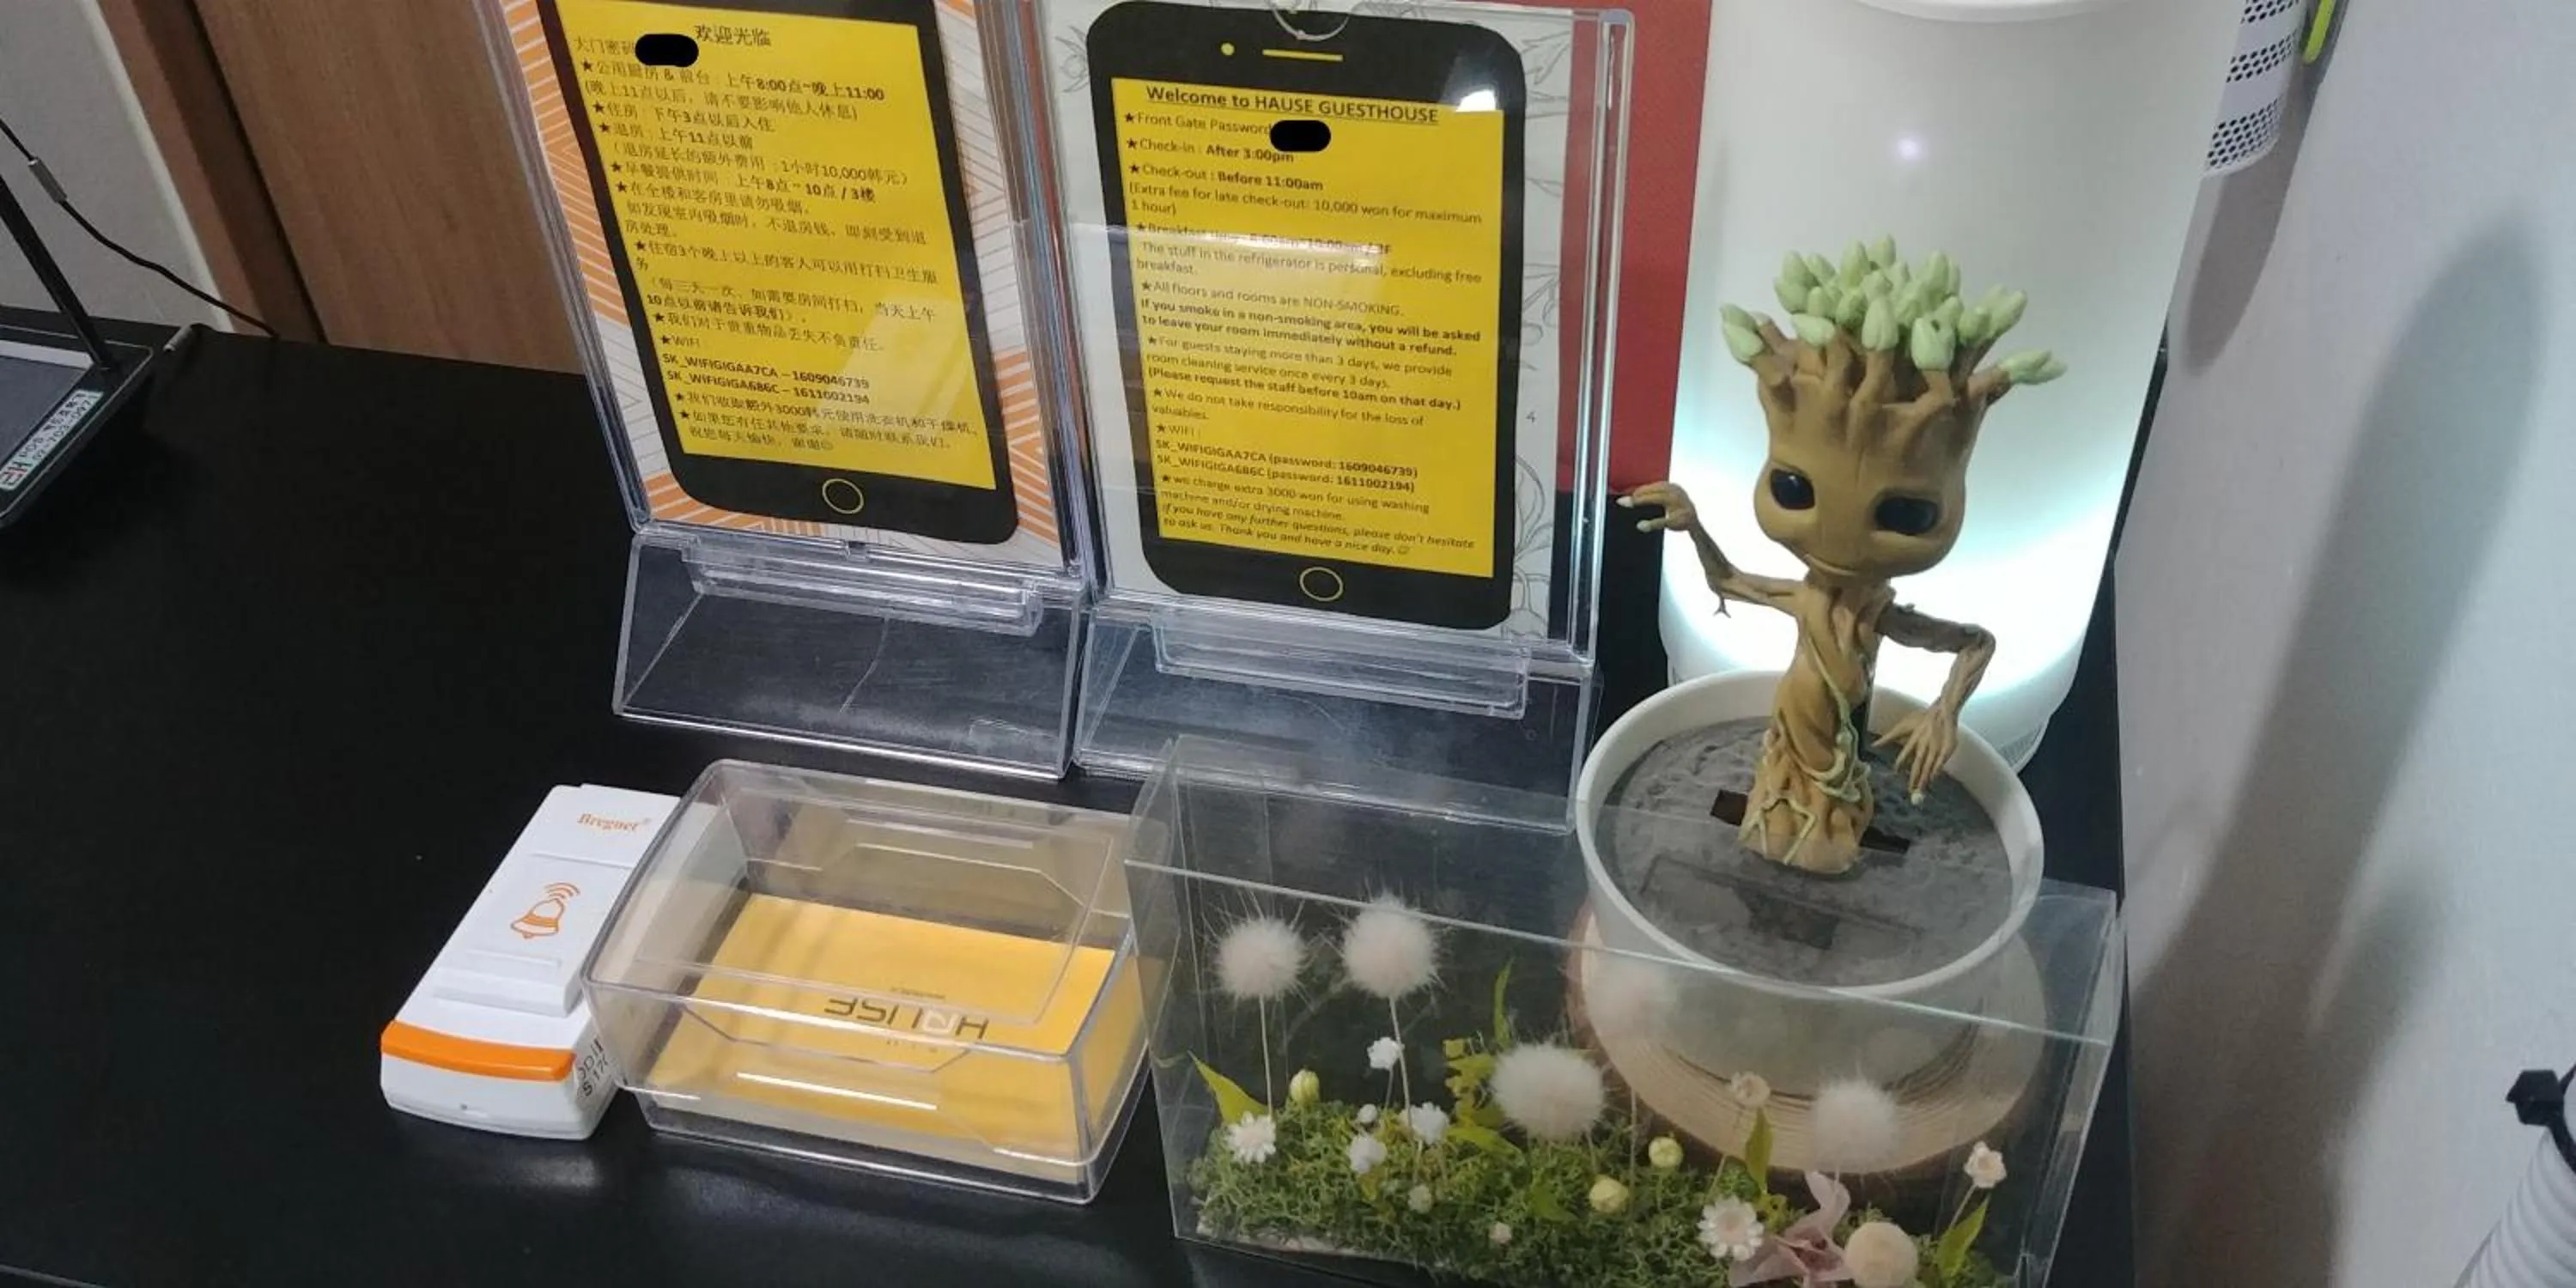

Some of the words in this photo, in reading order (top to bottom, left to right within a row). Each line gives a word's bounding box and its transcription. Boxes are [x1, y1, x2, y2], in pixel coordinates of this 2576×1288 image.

[691, 22, 773, 48] 欢迎光临
[661, 67, 674, 81] &
[1145, 85, 1228, 106] Welcome
[1231, 94, 1249, 108] to
[1255, 94, 1313, 113] HAUSE
[1317, 100, 1439, 124] GUESTHOUSE
[1136, 111, 1173, 126] Front
[1175, 114, 1206, 130] Gate
[1208, 116, 1272, 135] Password
[1139, 137, 1195, 155] Check-in
[1205, 143, 1239, 158] After
[1243, 147, 1294, 165] 3:00pm
[1142, 163, 1206, 180] Check-out
[1217, 170, 1262, 185] Before
[1265, 174, 1323, 191] 11:00am
[1128, 180, 1164, 197] (Extra
[1168, 185, 1189, 198] fee
[1192, 186, 1211, 200] for
[1214, 189, 1238, 203] late
[1242, 191, 1309, 210] check-out:
[1315, 198, 1358, 216] 10,000
[1361, 205, 1388, 217] won
[1393, 204, 1413, 218] for
[1415, 207, 1482, 225] maximum
[1130, 198, 1140, 210] 1
[1140, 198, 1176, 216] hour)
[1135, 257, 1196, 275] breakfast.
[1142, 240, 1164, 254] The
[1168, 244, 1197, 258] stuff
[1199, 247, 1211, 259] in
[1212, 248, 1236, 262] the
[1237, 251, 1309, 272] refrigerator
[1314, 258, 1325, 270] is
[1327, 259, 1386, 278] personal,
[1389, 264, 1452, 283] excluding
[1455, 269, 1481, 283] free
[1152, 280, 1170, 293] All
[1172, 282, 1207, 297] floors
[1211, 286, 1233, 300] and
[1236, 291, 1277, 304] rooms
[1279, 296, 1300, 307] are
[1302, 295, 1404, 317] NON-SMOKING.
[1140, 298, 1150, 310] If
[1151, 301, 1175, 313] you
[1178, 302, 1220, 317] smoke
[1222, 307, 1233, 319] in
[1236, 310, 1245, 319] a
[1248, 309, 1332, 330] non-smoking
[1334, 319, 1365, 332] area,
[1370, 322, 1393, 336] you
[1396, 323, 1419, 337] will
[1423, 325, 1438, 338] be
[1442, 327, 1480, 342] asked
[1142, 315, 1156, 325] to
[1158, 315, 1192, 329] leave
[1194, 321, 1223, 334] your
[1225, 324, 1259, 337] room
[1262, 326, 1341, 348] immediately
[1345, 334, 1395, 350] without
[1399, 343, 1406, 351] a
[1409, 340, 1456, 356] refund.
[1158, 336, 1178, 348] For
[1181, 339, 1221, 354] guests
[1223, 343, 1267, 359] staying
[1269, 349, 1303, 361] more
[1304, 351, 1333, 364] than
[1337, 355, 1343, 365] 3
[1346, 355, 1378, 371] days,
[1382, 361, 1400, 372] we
[1404, 361, 1452, 379] provide
[791, 369, 870, 390] 1609046739
[1145, 354, 1179, 365] room
[1180, 355, 1232, 373] cleaning
[1234, 361, 1276, 376] service
[1278, 368, 1309, 380] once
[1311, 371, 1346, 385] every
[1349, 374, 1356, 385] 3
[1359, 374, 1390, 390] days.
[792, 386, 871, 405] 1611002194
[1147, 366, 1191, 382] (Please
[1194, 372, 1241, 388] request
[1243, 377, 1265, 390] the
[1267, 379, 1296, 393] staff
[1297, 382, 1340, 398] before
[1342, 389, 1377, 402] 10am
[1379, 393, 1396, 404] on
[1400, 394, 1425, 407] that
[1428, 395, 1461, 411] day.)
[1151, 403, 1209, 420] valuables.
[1163, 388, 1183, 400] We
[1187, 391, 1203, 402] do
[1204, 393, 1225, 404] not
[1228, 395, 1254, 408] take
[1257, 398, 1338, 419] responsibility
[1340, 407, 1358, 420] for
[1361, 410, 1381, 422] the
[1384, 411, 1408, 425] loss
[1411, 414, 1424, 426] of
[1526, 410, 1536, 422] 4
[1268, 451, 1336, 471] (password:
[1339, 458, 1418, 478] 1609046739)
[1266, 466, 1334, 486] (password:
[1336, 472, 1415, 494] 1611002194)
[1160, 488, 1210, 504] machine
[1211, 495, 1251, 510] and/or
[1252, 500, 1290, 516] drying
[1173, 476, 1189, 485] we
[1192, 476, 1230, 492] charge
[1233, 482, 1263, 494] extra
[1266, 485, 1296, 499] 3000
[1298, 490, 1323, 501] won
[1326, 492, 1344, 504] for
[1346, 495, 1378, 509] using
[1381, 498, 1430, 515] washing
[1163, 517, 1176, 526] to
[1177, 517, 1199, 529] ask
[1218, 523, 1253, 536] Thank
[1255, 529, 1277, 541] you
[1279, 531, 1302, 542] and
[1304, 533, 1332, 546] have
[1334, 538, 1341, 547] a
[1344, 538, 1369, 550] nice
[1371, 542, 1394, 555] day.
[1173, 504, 1194, 515] you
[1195, 506, 1224, 519] have
[1225, 511, 1248, 523] any
[1249, 513, 1289, 528] further
[1291, 519, 1350, 536] questions,
[1352, 525, 1390, 541] please
[1425, 532, 1474, 550] hesitate
